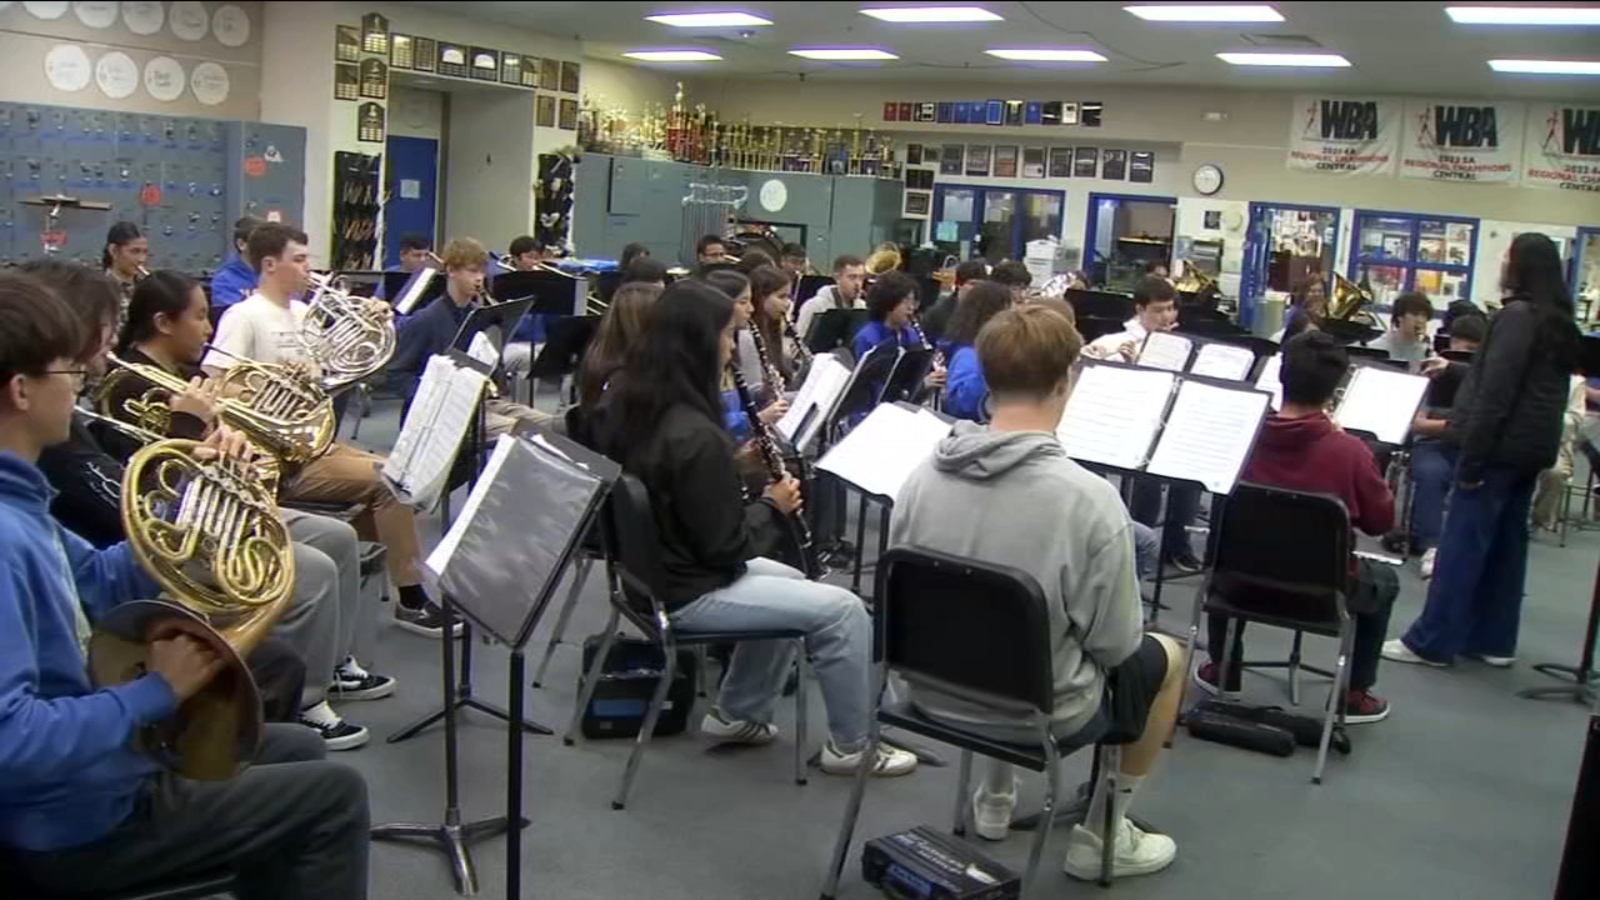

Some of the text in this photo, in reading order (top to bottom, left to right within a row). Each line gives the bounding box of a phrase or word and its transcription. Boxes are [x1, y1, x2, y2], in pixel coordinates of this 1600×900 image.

[1321, 99, 1377, 140] WBA
[1435, 105, 1498, 148] WBA
[1316, 162, 1357, 171] CENTRAL
[1404, 158, 1512, 173] REGIONAL CHAMPIONS
[1432, 170, 1477, 181] CENTRAL
[1528, 169, 1578, 182] REGIONAL
